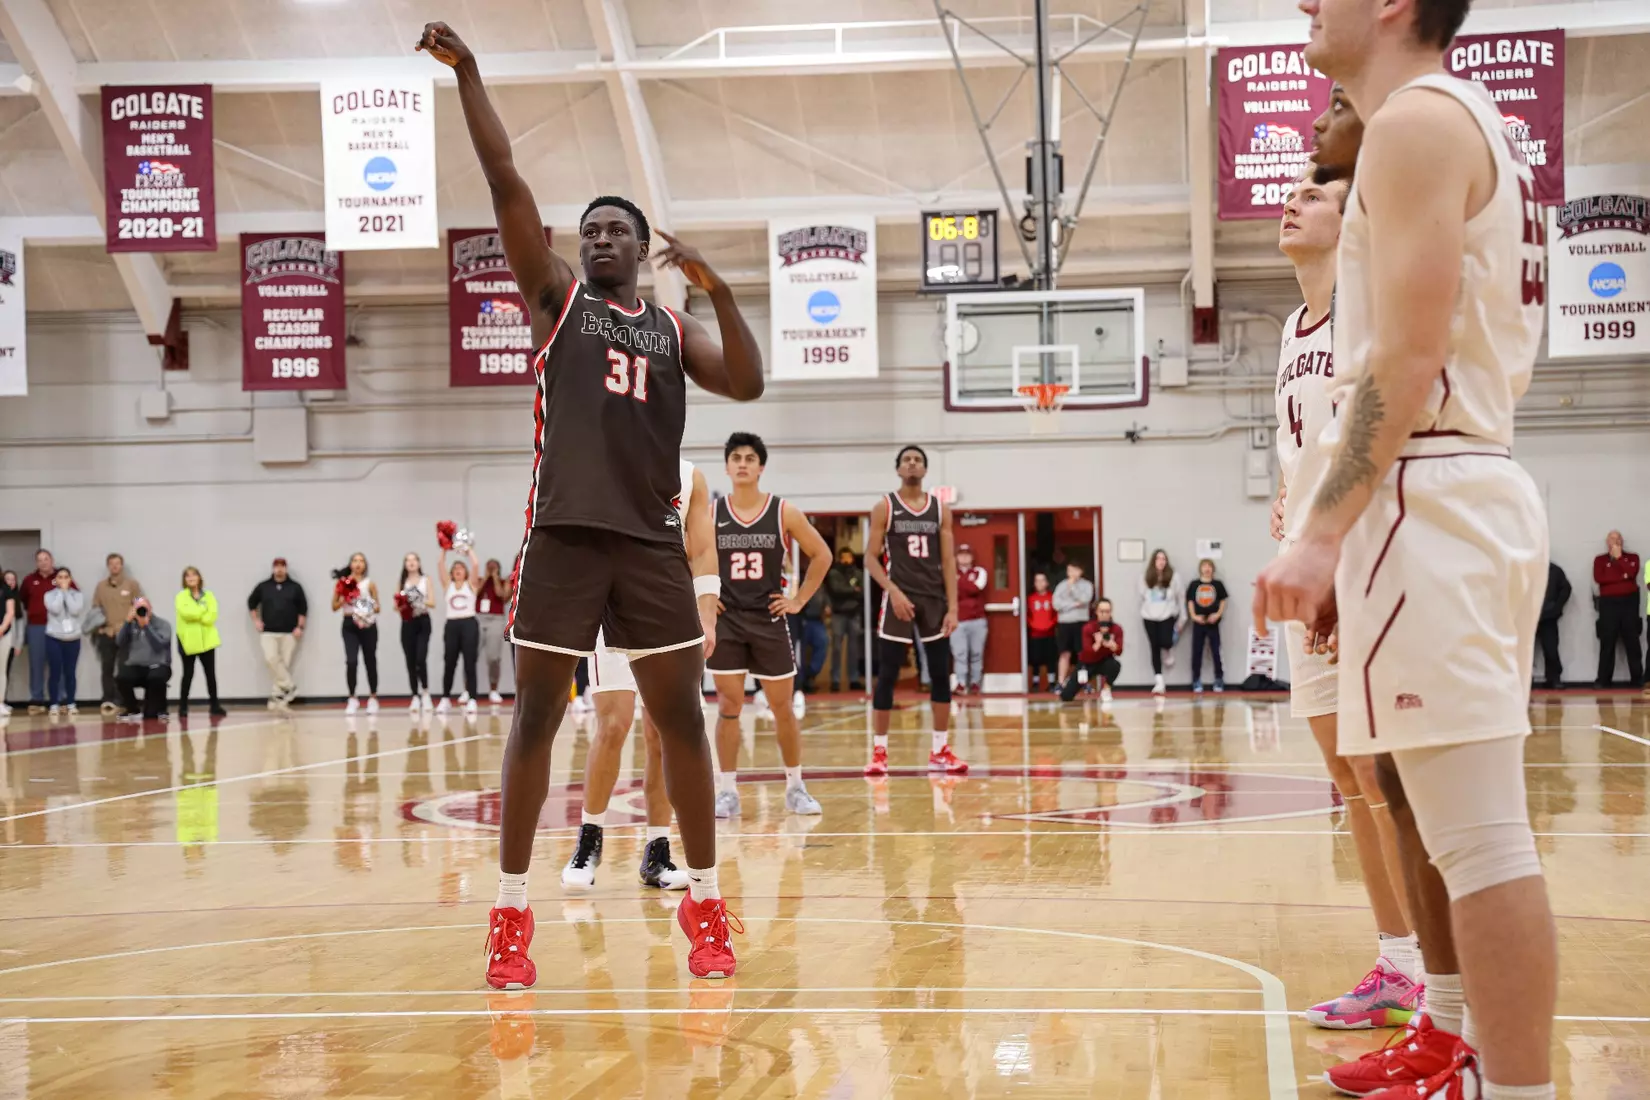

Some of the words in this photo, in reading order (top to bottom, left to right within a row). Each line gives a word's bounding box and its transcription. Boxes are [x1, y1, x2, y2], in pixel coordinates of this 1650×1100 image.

[1451, 39, 1555, 72] COLGATE
[1471, 68, 1534, 82] RAIDERS
[1247, 80, 1308, 92] RAIDERS
[111, 91, 204, 121] COLGATE
[333, 89, 422, 115] COLGATE
[1243, 100, 1312, 114] VOLLEYBALL
[130, 120, 186, 131] RAIDERS
[141, 132, 176, 145] MEN'S
[348, 141, 410, 151] BASKETBALL
[126, 144, 192, 157] BASKETBALL
[120, 187, 200, 200] TOURNAMENT
[120, 200, 201, 213] CHAMPIONS
[338, 195, 425, 209] TOURNAMENT
[118, 217, 204, 239] 2020-21
[359, 215, 404, 233] 2021
[929, 216, 979, 241] 06.8
[1568, 242, 1647, 256] VOLLEYBALL
[789, 271, 859, 284] VOLLEYBALL
[257, 284, 329, 298] VOLLEYBALL
[263, 308, 325, 322] REGULAR
[267, 322, 320, 336] SEASON
[581, 311, 670, 357] BROWN
[782, 328, 867, 341] TOURNAMENT
[1583, 320, 1636, 341] 1999
[254, 335, 333, 351] CHAMPIONS
[479, 352, 528, 374] 1996
[804, 346, 850, 365] 1996
[272, 357, 320, 379] 1996
[604, 347, 649, 403] 31
[717, 533, 777, 550] BROWN
[907, 534, 930, 559] 21
[730, 551, 764, 581] 23
